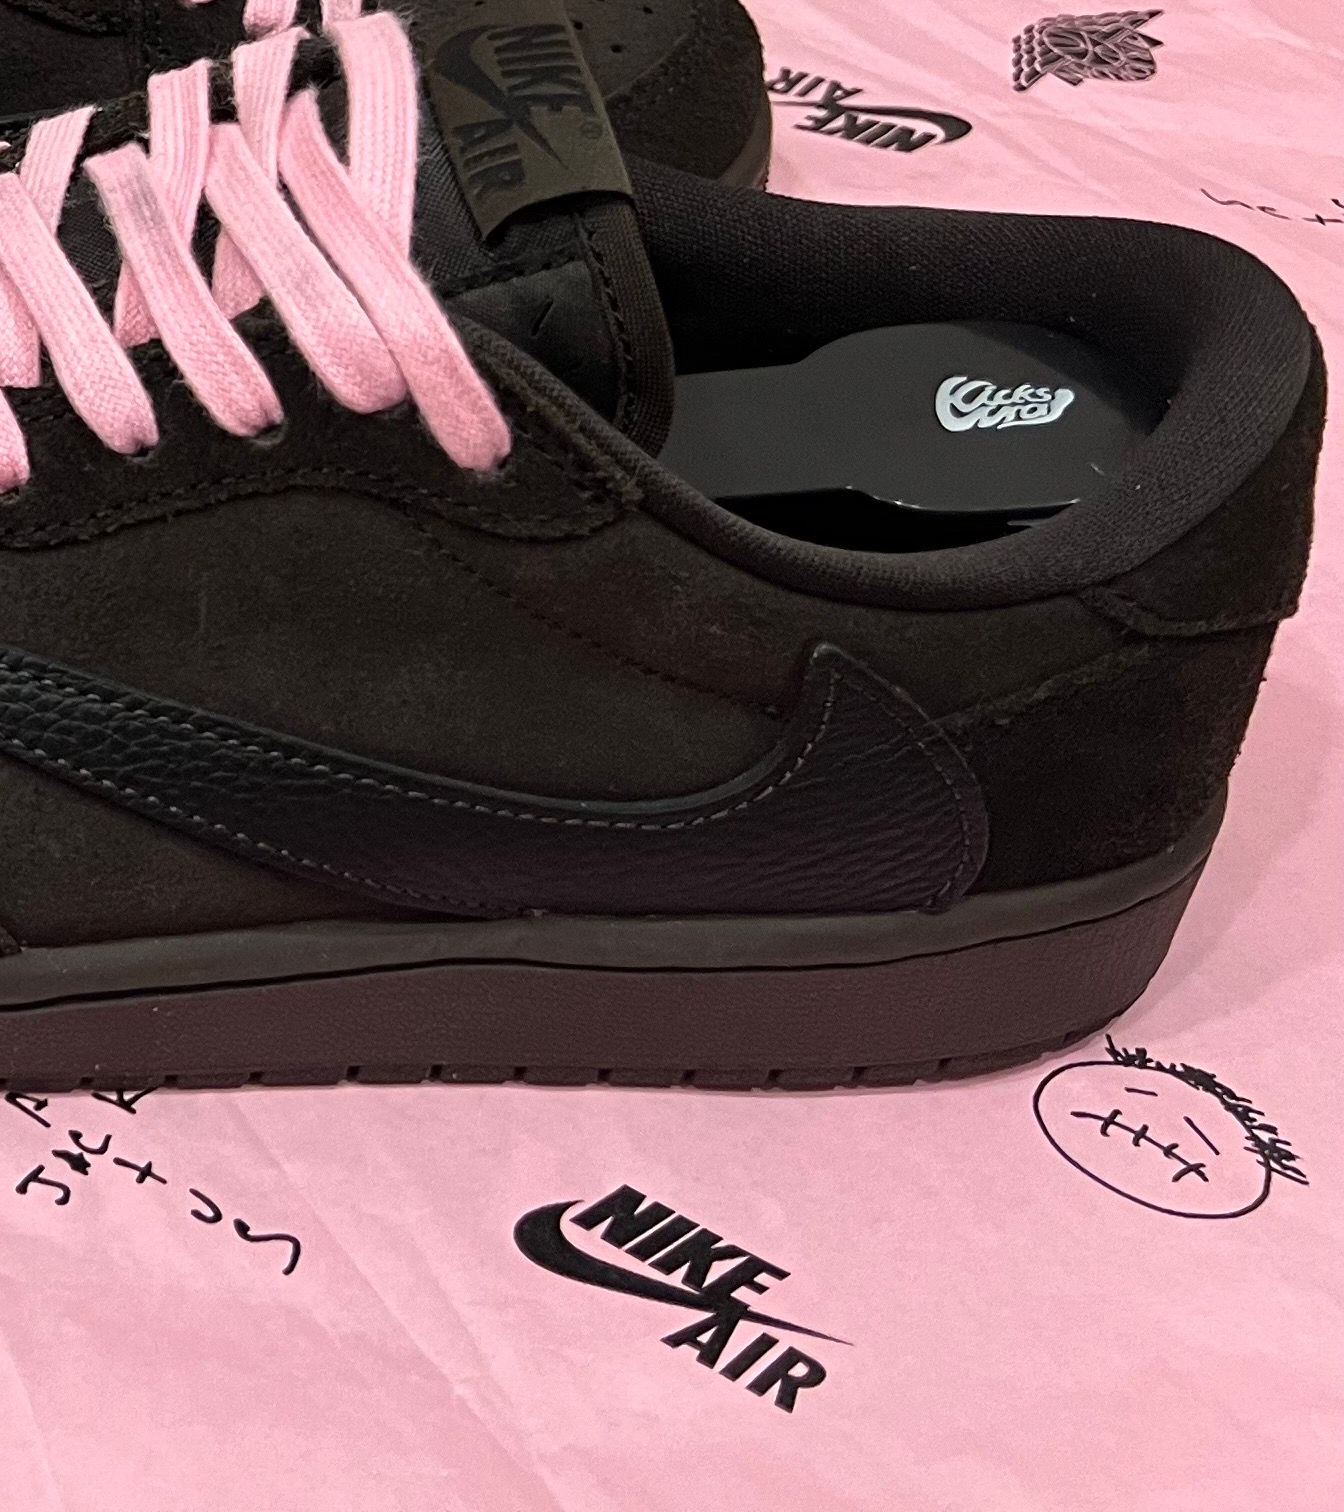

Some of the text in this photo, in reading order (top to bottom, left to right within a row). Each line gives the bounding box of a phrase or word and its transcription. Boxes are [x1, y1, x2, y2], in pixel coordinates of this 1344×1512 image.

[486, 23, 597, 118] NIKE
[452, 117, 526, 199] AIR
[793, 102, 938, 153] NIKE
[569, 1184, 792, 1304] NIKE
[660, 1302, 827, 1414] AIR
